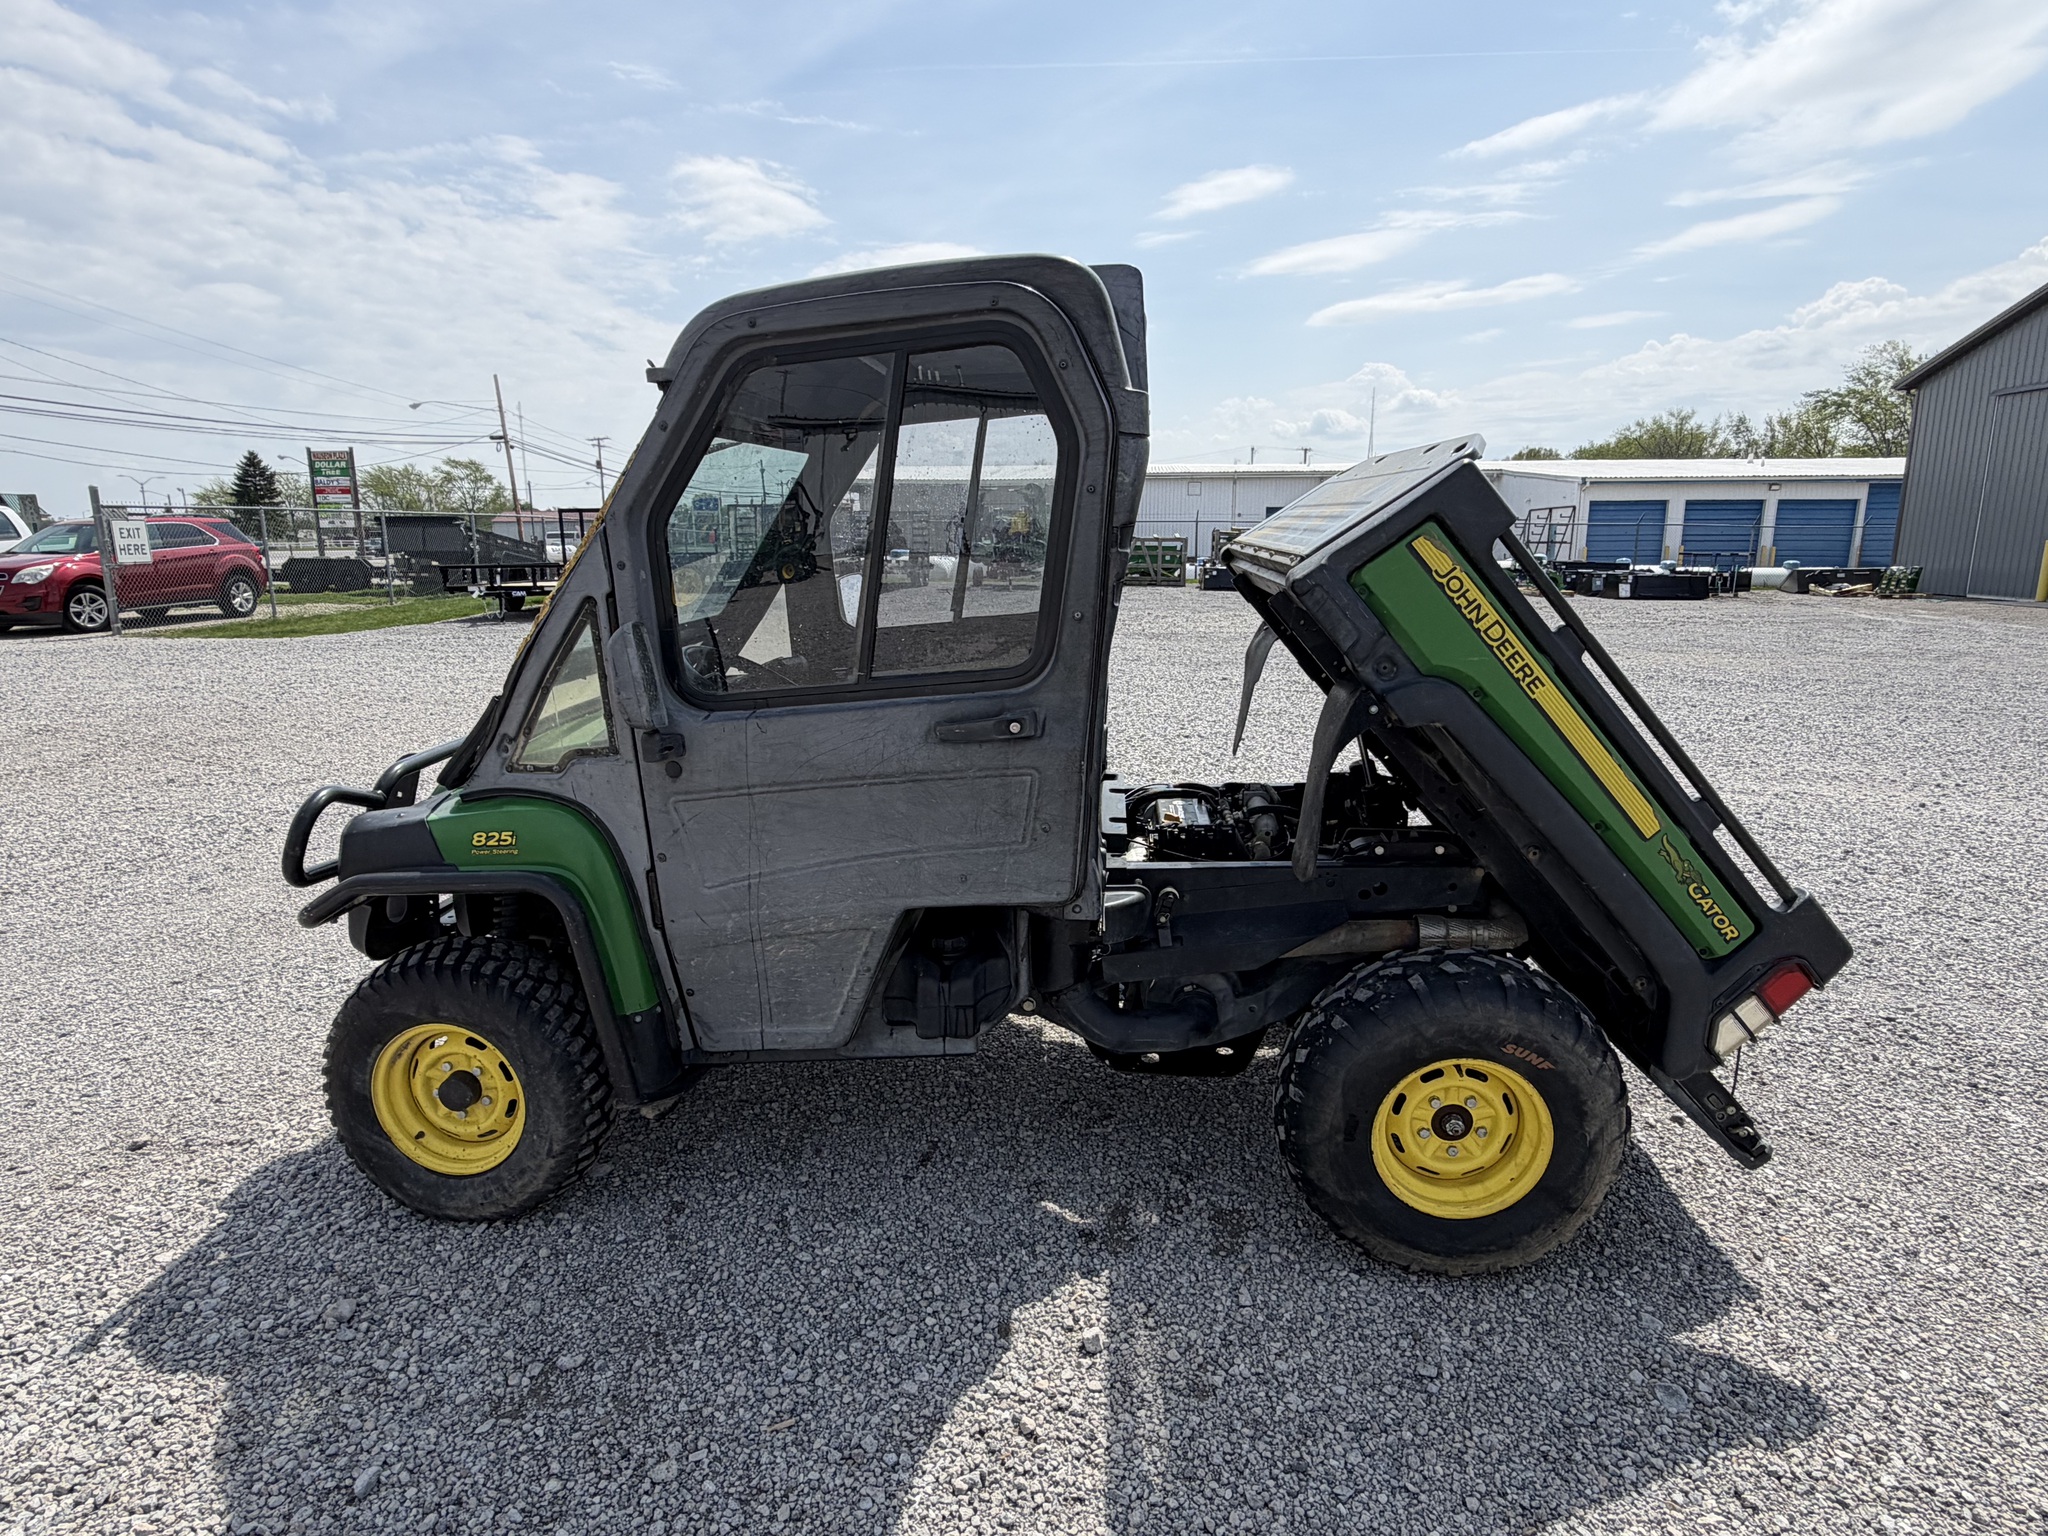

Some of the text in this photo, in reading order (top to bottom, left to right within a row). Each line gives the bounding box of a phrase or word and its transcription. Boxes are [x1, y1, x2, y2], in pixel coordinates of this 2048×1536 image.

[118, 527, 141, 539] EXIT
[118, 543, 148, 556] HERE
[1433, 566, 1547, 696] JOHN DEERE
[471, 831, 517, 847] 825i
[1688, 882, 1740, 941] GATOR
